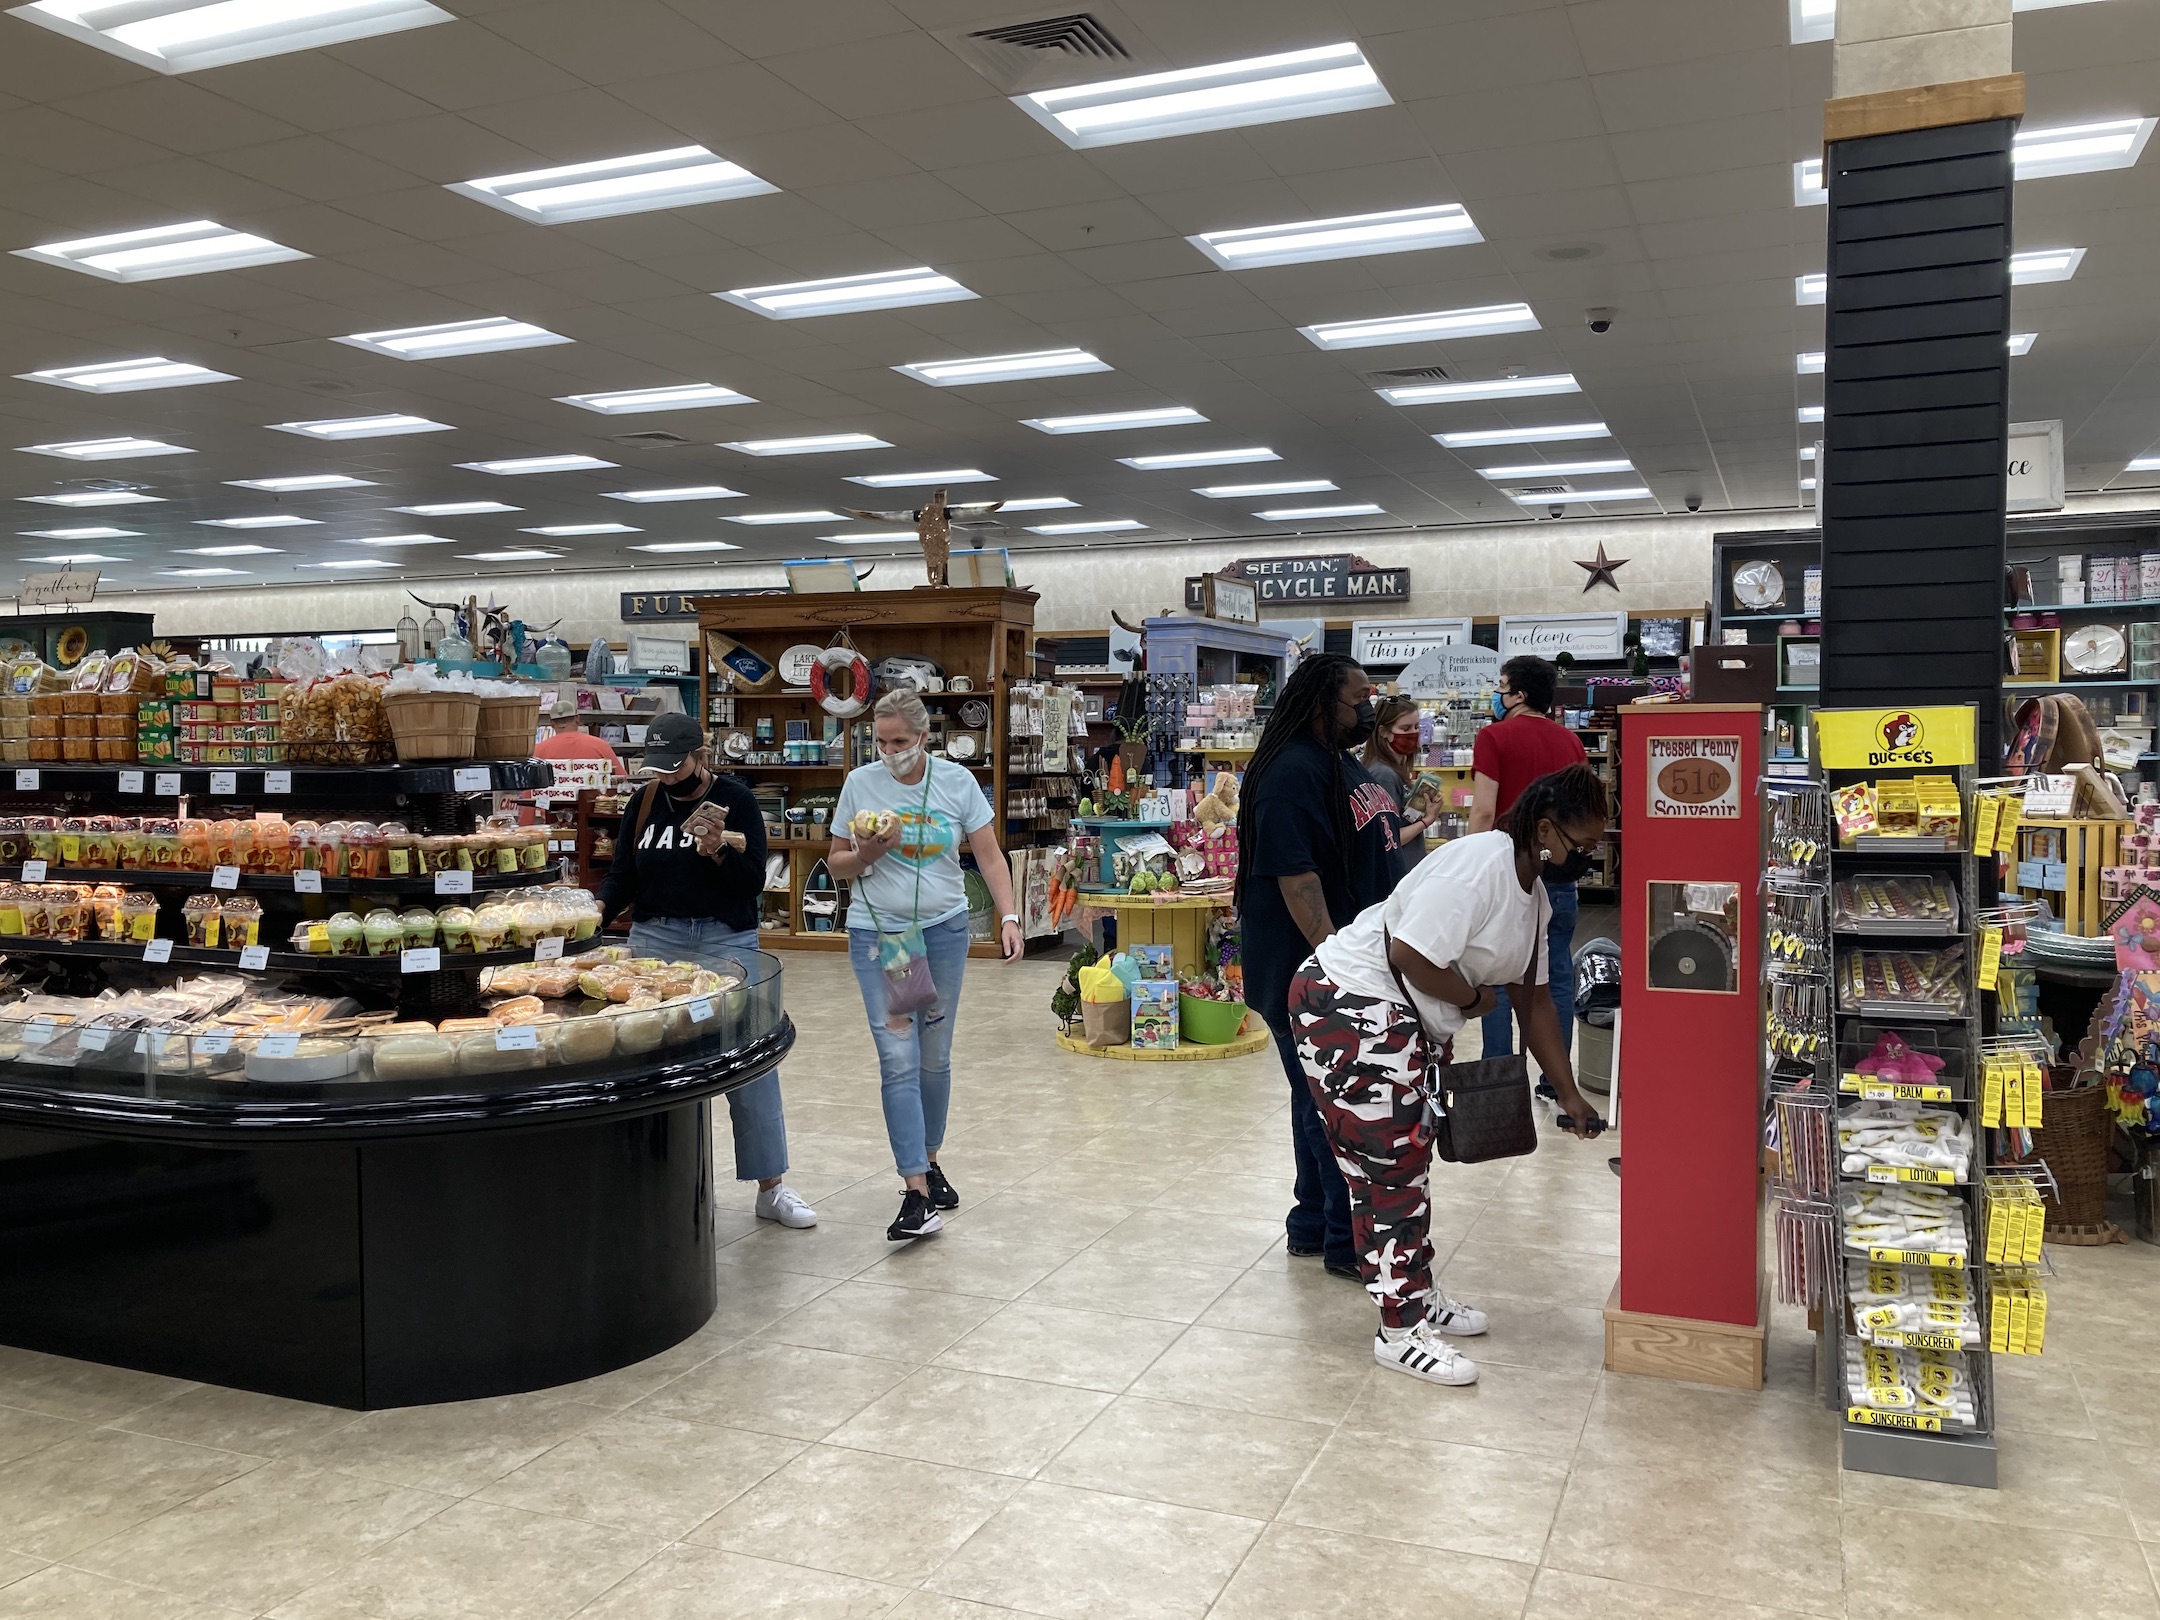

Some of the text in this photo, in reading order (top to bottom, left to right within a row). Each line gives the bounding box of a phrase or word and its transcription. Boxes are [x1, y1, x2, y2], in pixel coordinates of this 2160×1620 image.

[1246, 562, 1283, 575] SEE
[1347, 574, 1402, 596] MAN.
[1509, 625, 1606, 646] welcome
[1371, 643, 1397, 658] this
[1404, 644, 1416, 656] is
[1449, 656, 1497, 664] Fredericksburg
[793, 668, 811, 676] LIF
[1449, 664, 1469, 673] Farms
[1651, 739, 1739, 763] Pressed Penny
[1869, 750, 1934, 766] BUC-EE'S
[1654, 799, 1737, 816] Souvenir
[1900, 1087, 1923, 1098] BALM
[1910, 1169, 1939, 1182] LOTION
[1901, 1251, 1931, 1265] LOTION
[1906, 1333, 1955, 1350] SUNSCREEN
[1870, 1412, 1918, 1429] SUNSCREEN
